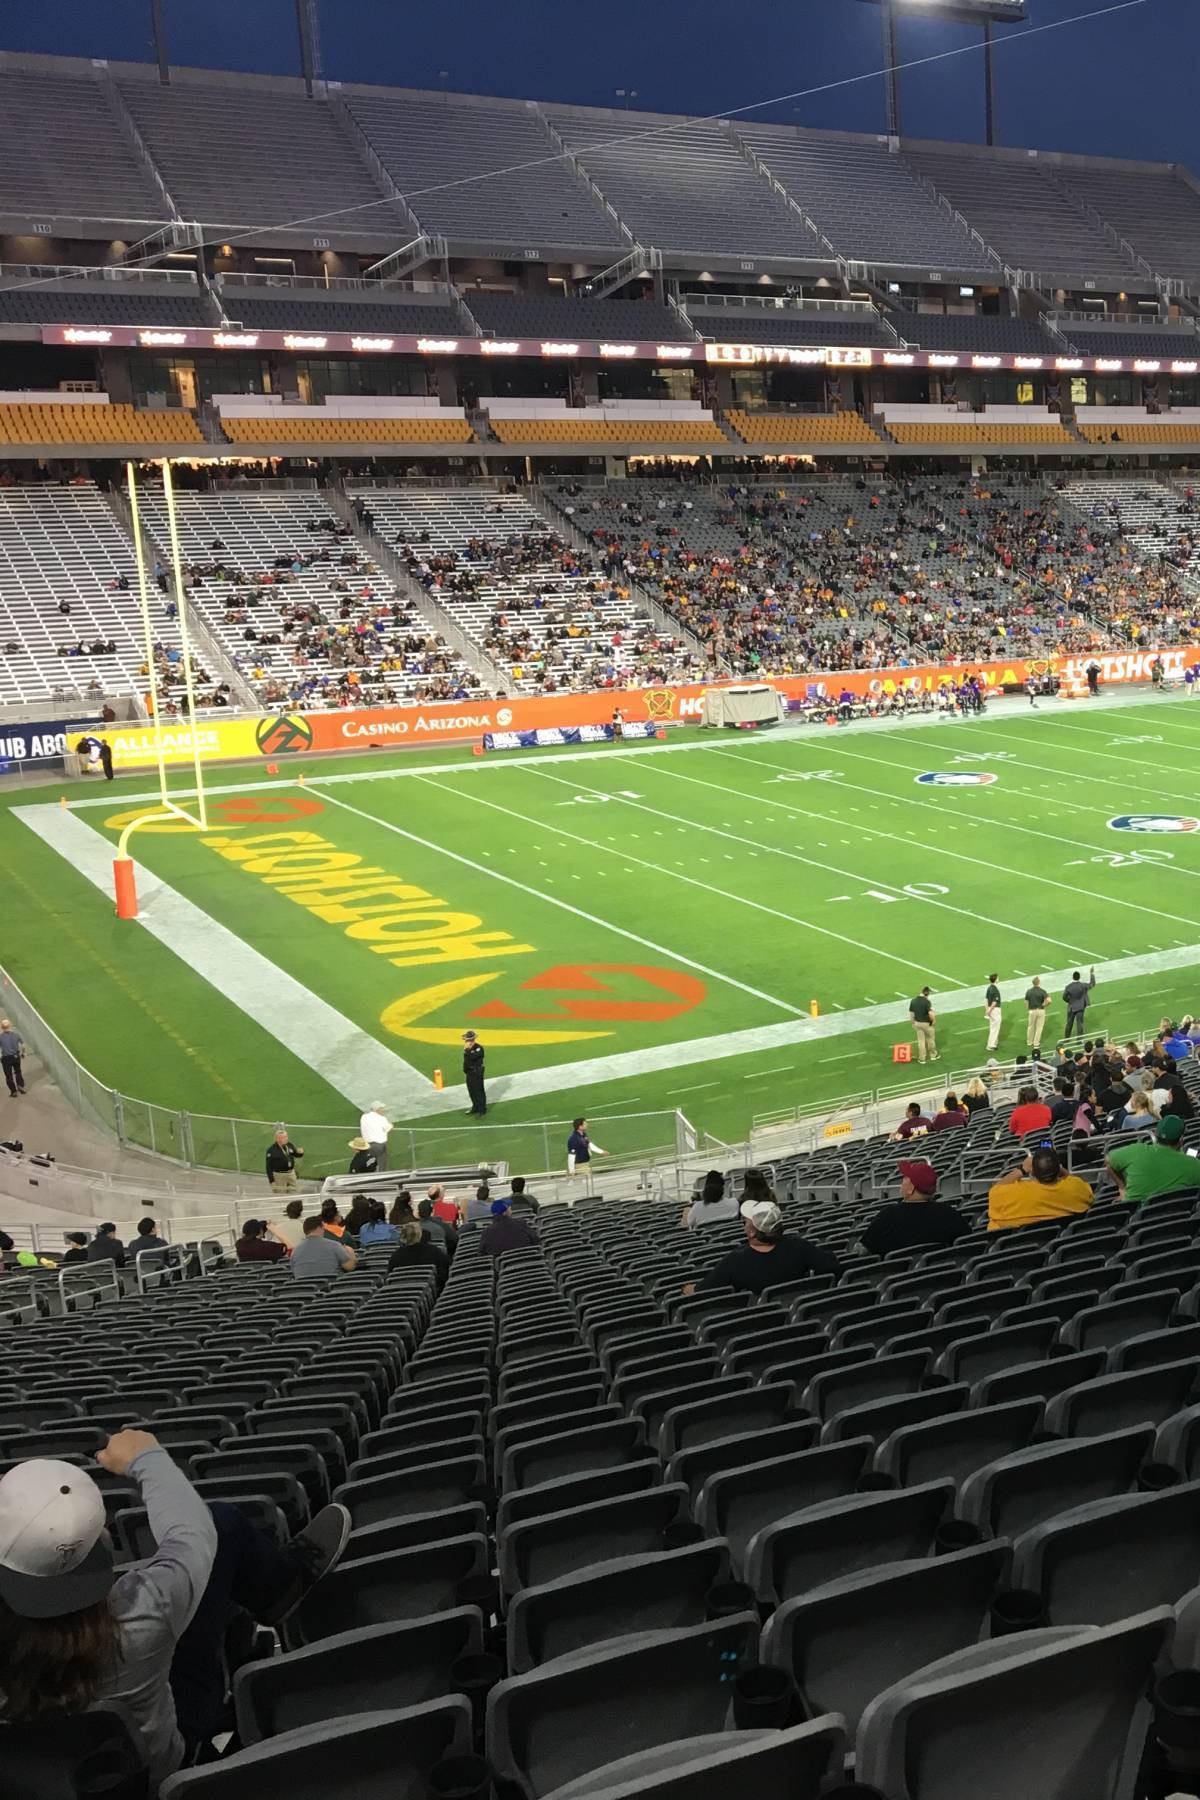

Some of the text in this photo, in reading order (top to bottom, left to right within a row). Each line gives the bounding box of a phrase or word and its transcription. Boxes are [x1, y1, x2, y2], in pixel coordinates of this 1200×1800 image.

[342, 714, 491, 738] CASINO ARIZONA
[31, 733, 67, 757] ABO
[1091, 849, 1175, 868] 20
[861, 882, 950, 903] 10
[898, 1046, 907, 1060] G
